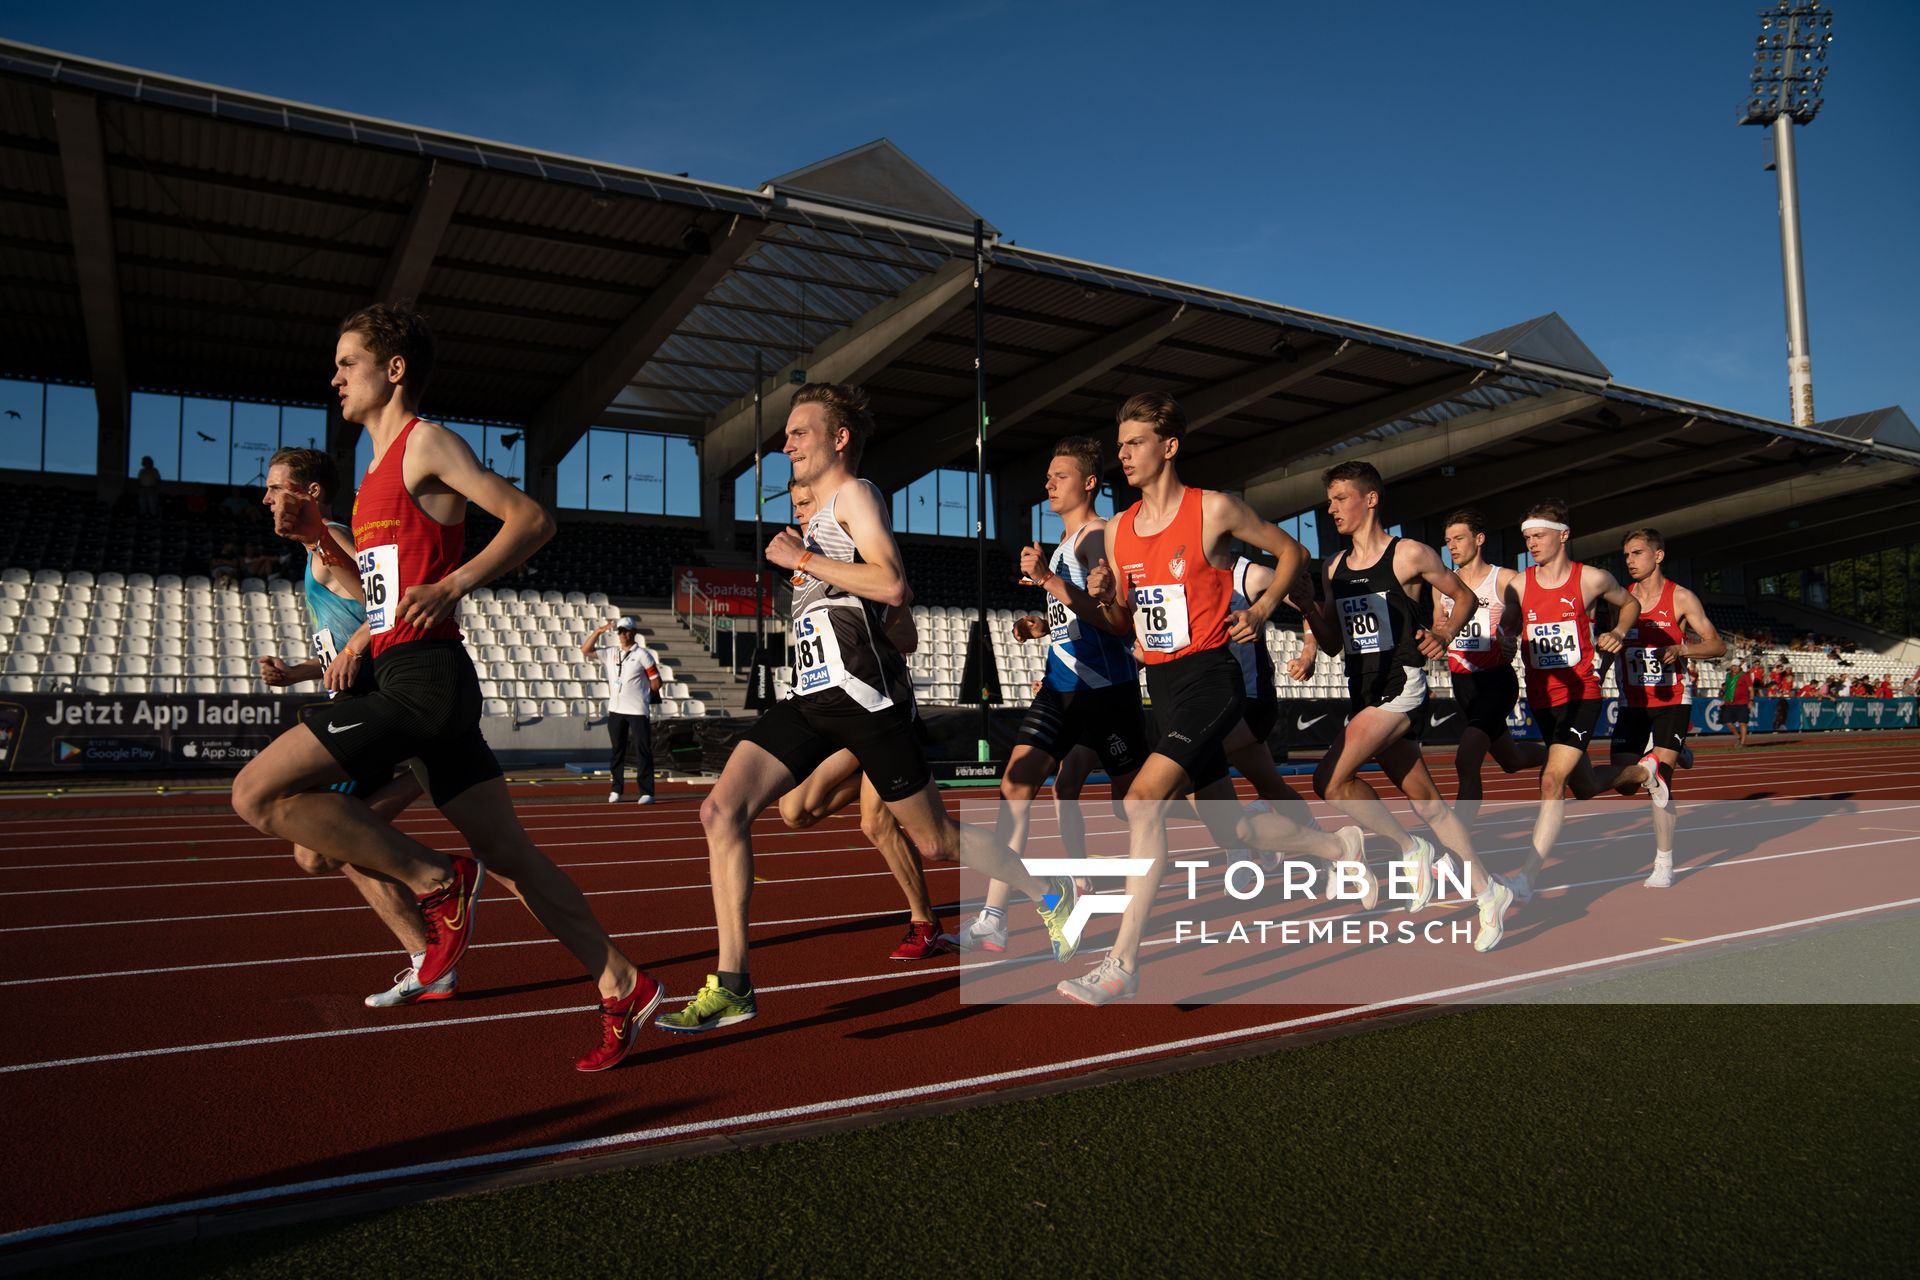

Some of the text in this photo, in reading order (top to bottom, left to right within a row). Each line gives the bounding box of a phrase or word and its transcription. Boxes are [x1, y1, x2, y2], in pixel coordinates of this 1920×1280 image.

[974, 277, 979, 288] 6
[977, 521, 981, 532] 3
[1141, 606, 1168, 631] 78
[1345, 612, 1379, 635] 580
[1456, 622, 1482, 638] 90
[1360, 638, 1378, 646] PLAN
[1530, 635, 1576, 654] 1084
[809, 670, 827, 682] PLAN
[46, 699, 281, 730] Jetzt App laden!
[86, 747, 156, 761] Google Play
[201, 747, 226, 759] App
